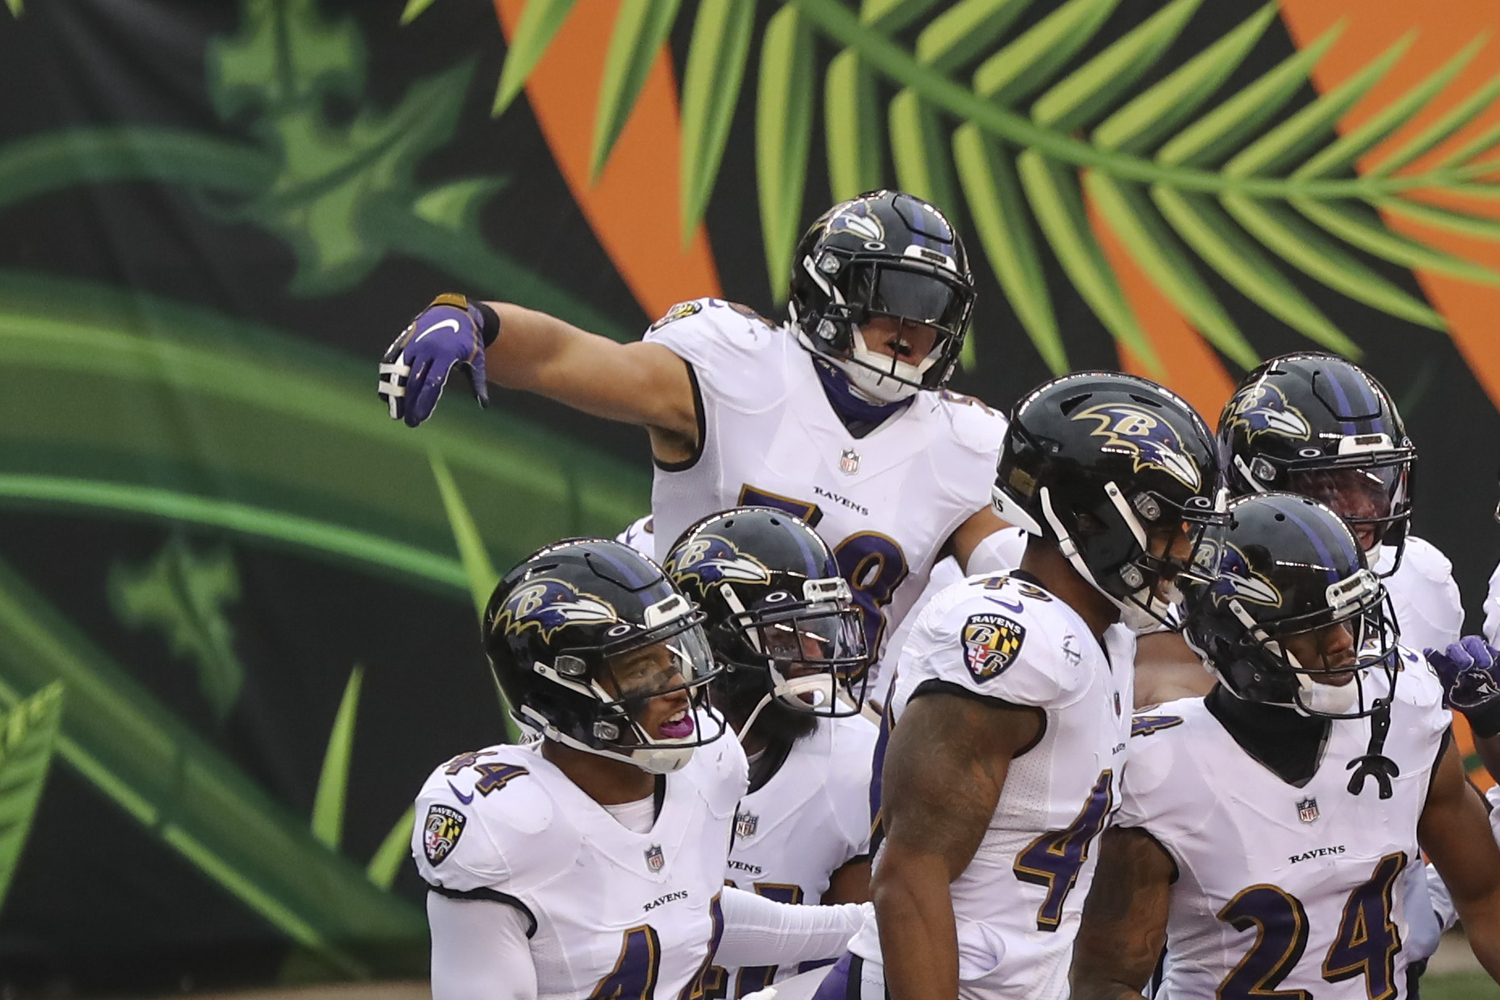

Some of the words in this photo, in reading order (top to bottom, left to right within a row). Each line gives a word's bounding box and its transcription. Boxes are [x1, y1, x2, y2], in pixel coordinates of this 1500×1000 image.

[1110, 408, 1158, 437] B
[814, 486, 869, 516] RAVENS
[679, 538, 711, 571] B
[513, 584, 548, 621] B
[971, 615, 1021, 635] RAVENS
[1131, 714, 1183, 738] 4
[430, 806, 464, 823] RAVENS
[1300, 808, 1318, 820] NFL
[1013, 769, 1127, 933] 4
[1289, 844, 1346, 865] RAVENS
[728, 860, 763, 875] VENS
[643, 890, 689, 912] RAVENS
